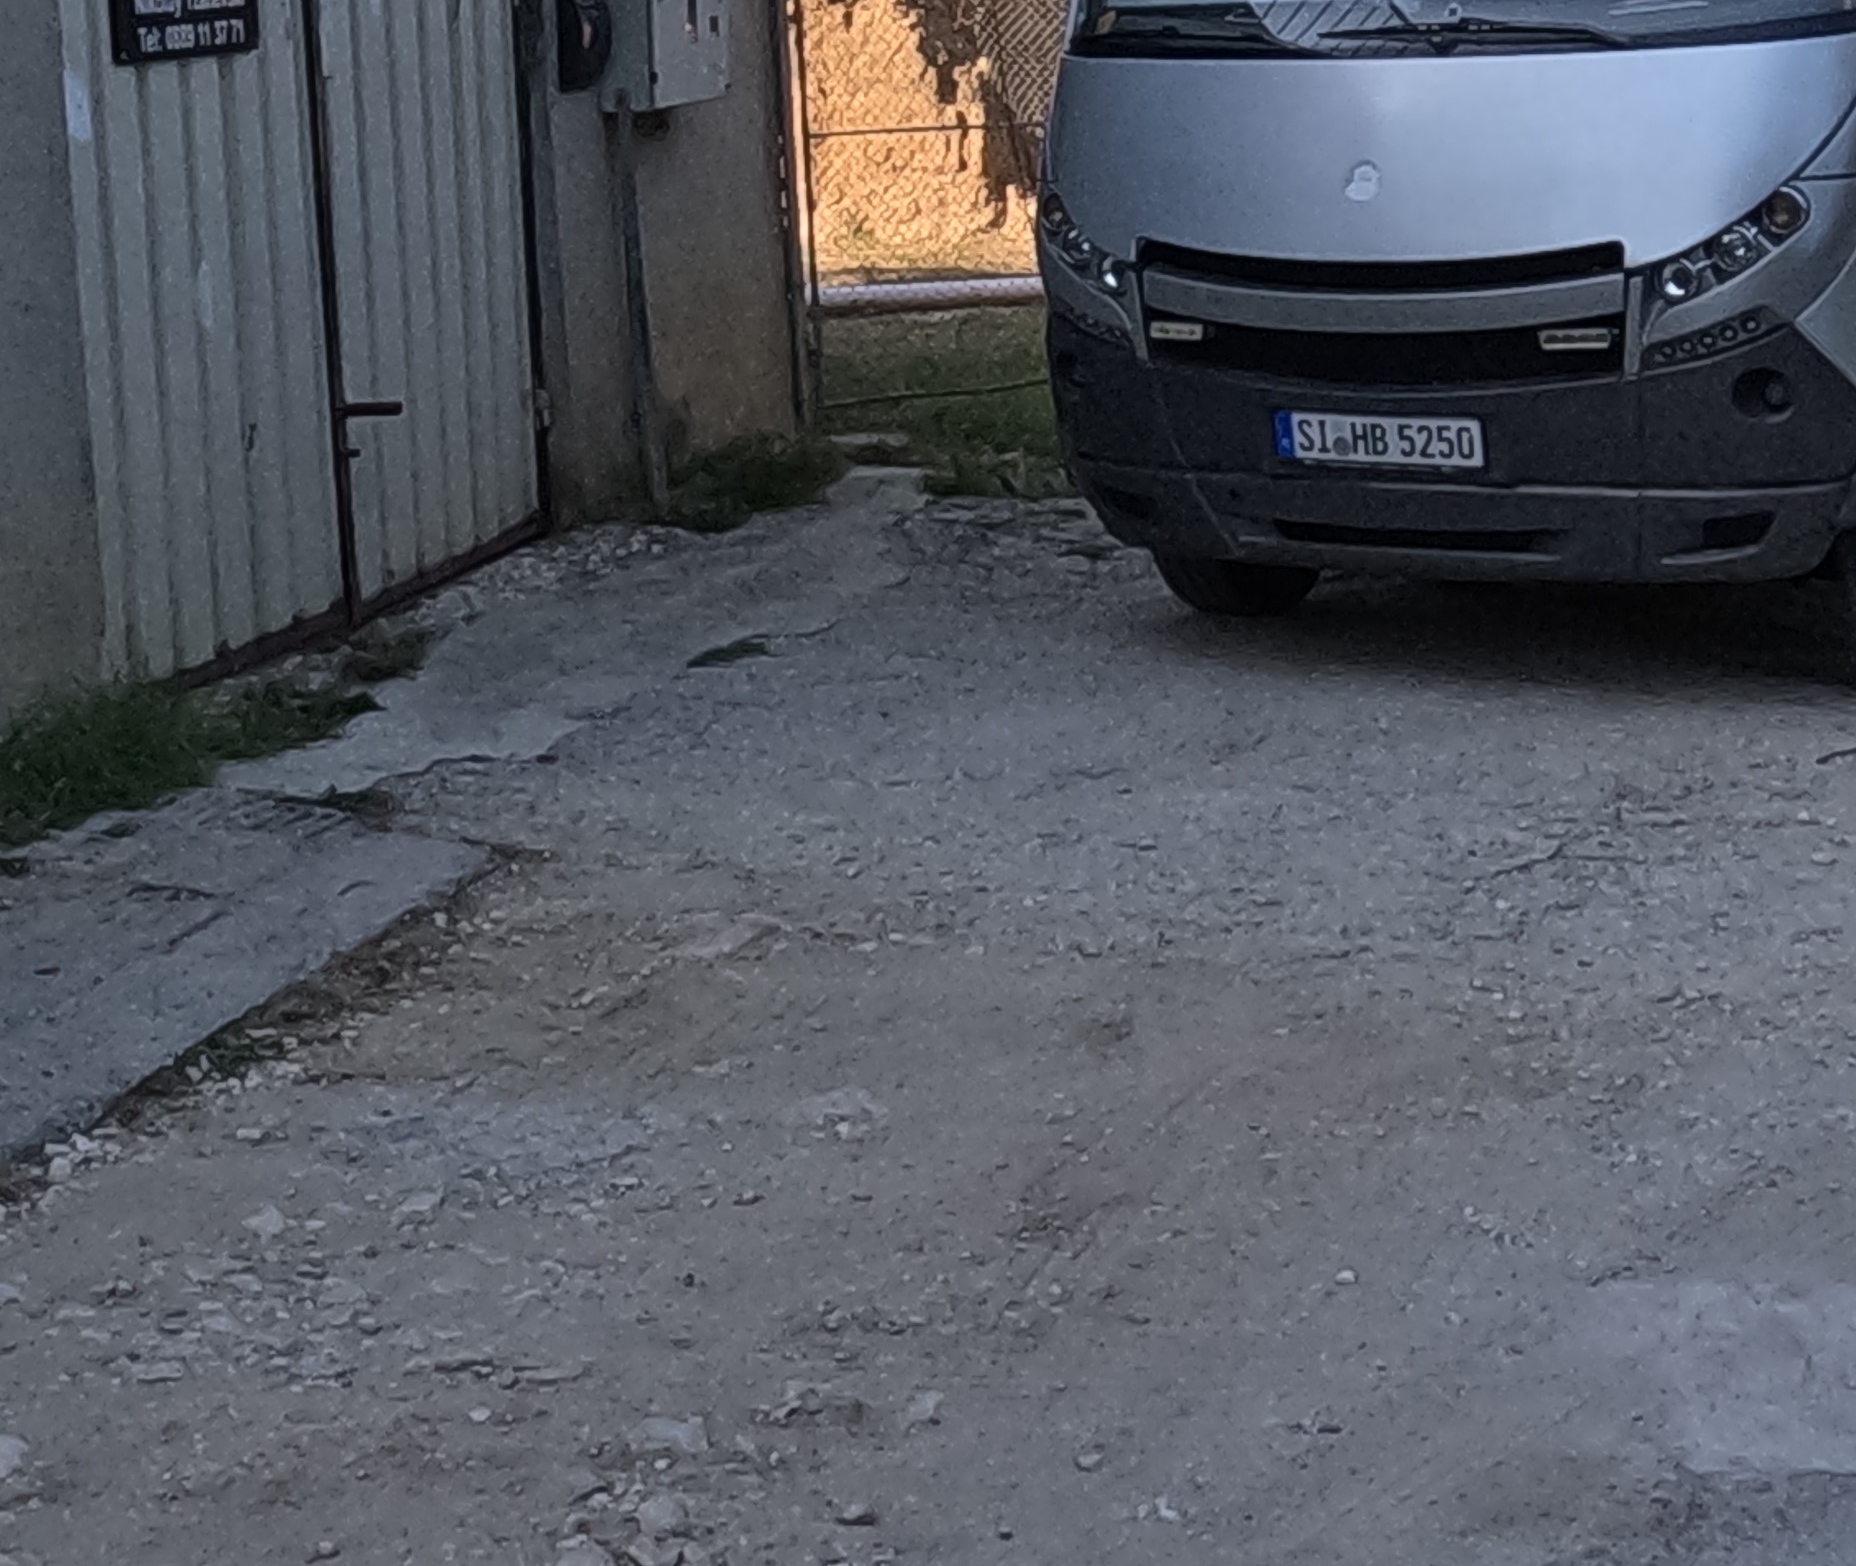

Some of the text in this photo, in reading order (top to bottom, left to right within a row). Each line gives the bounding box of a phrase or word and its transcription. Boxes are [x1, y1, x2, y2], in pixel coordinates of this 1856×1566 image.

[1297, 419, 1475, 460] SI HB 5250
